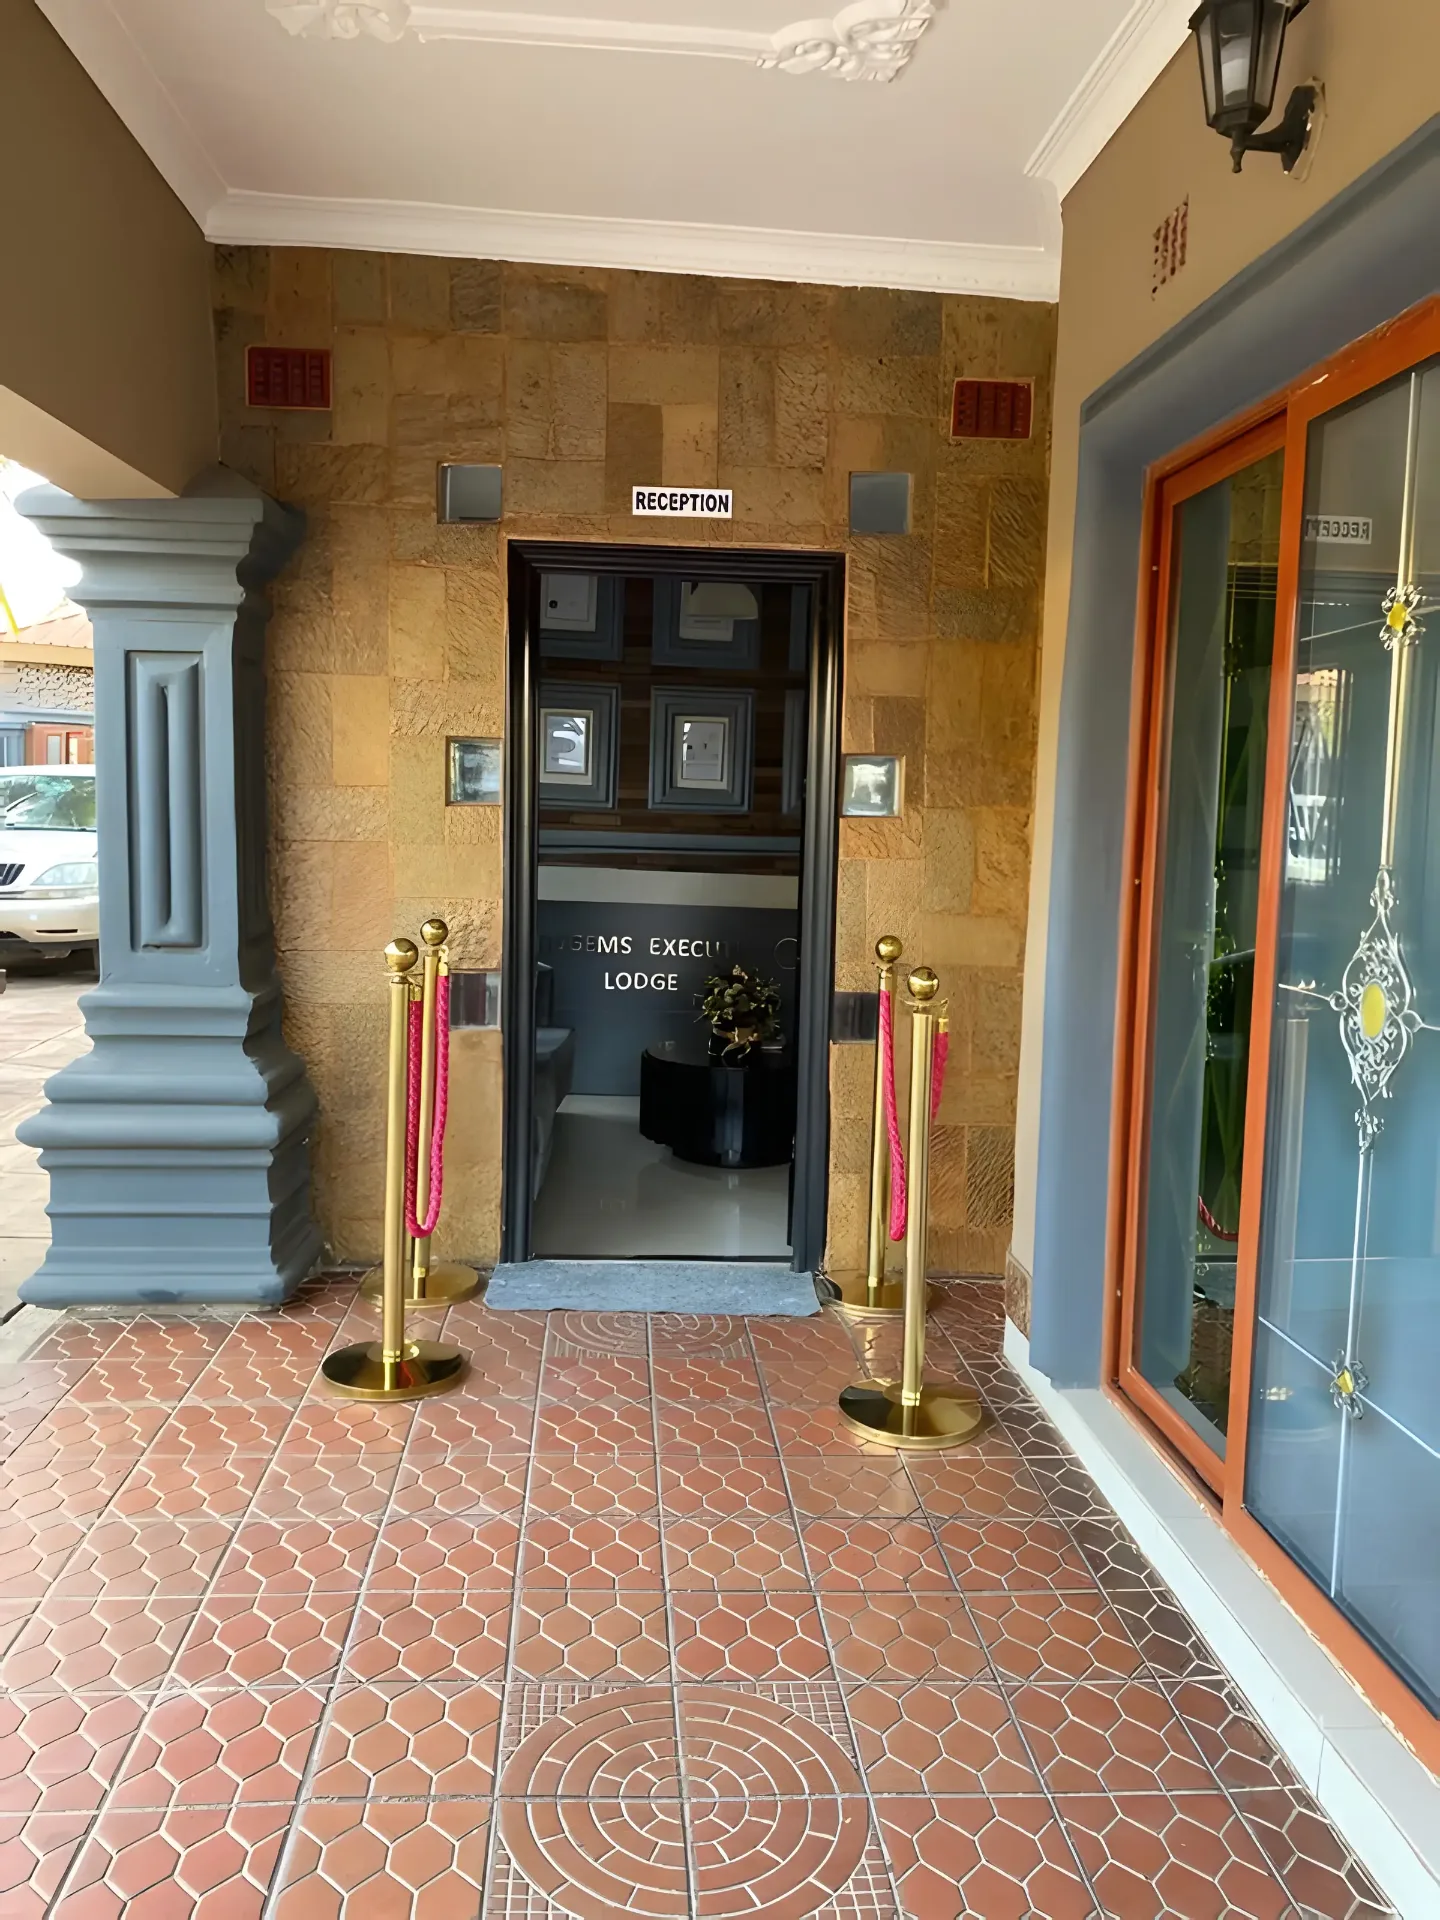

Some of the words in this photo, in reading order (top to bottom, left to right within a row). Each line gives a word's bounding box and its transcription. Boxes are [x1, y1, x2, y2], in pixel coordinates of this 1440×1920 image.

[635, 491, 729, 513] RECEPTION
[558, 934, 633, 955] GEMS
[649, 937, 740, 959] EXECU
[604, 971, 678, 991] LODGE
